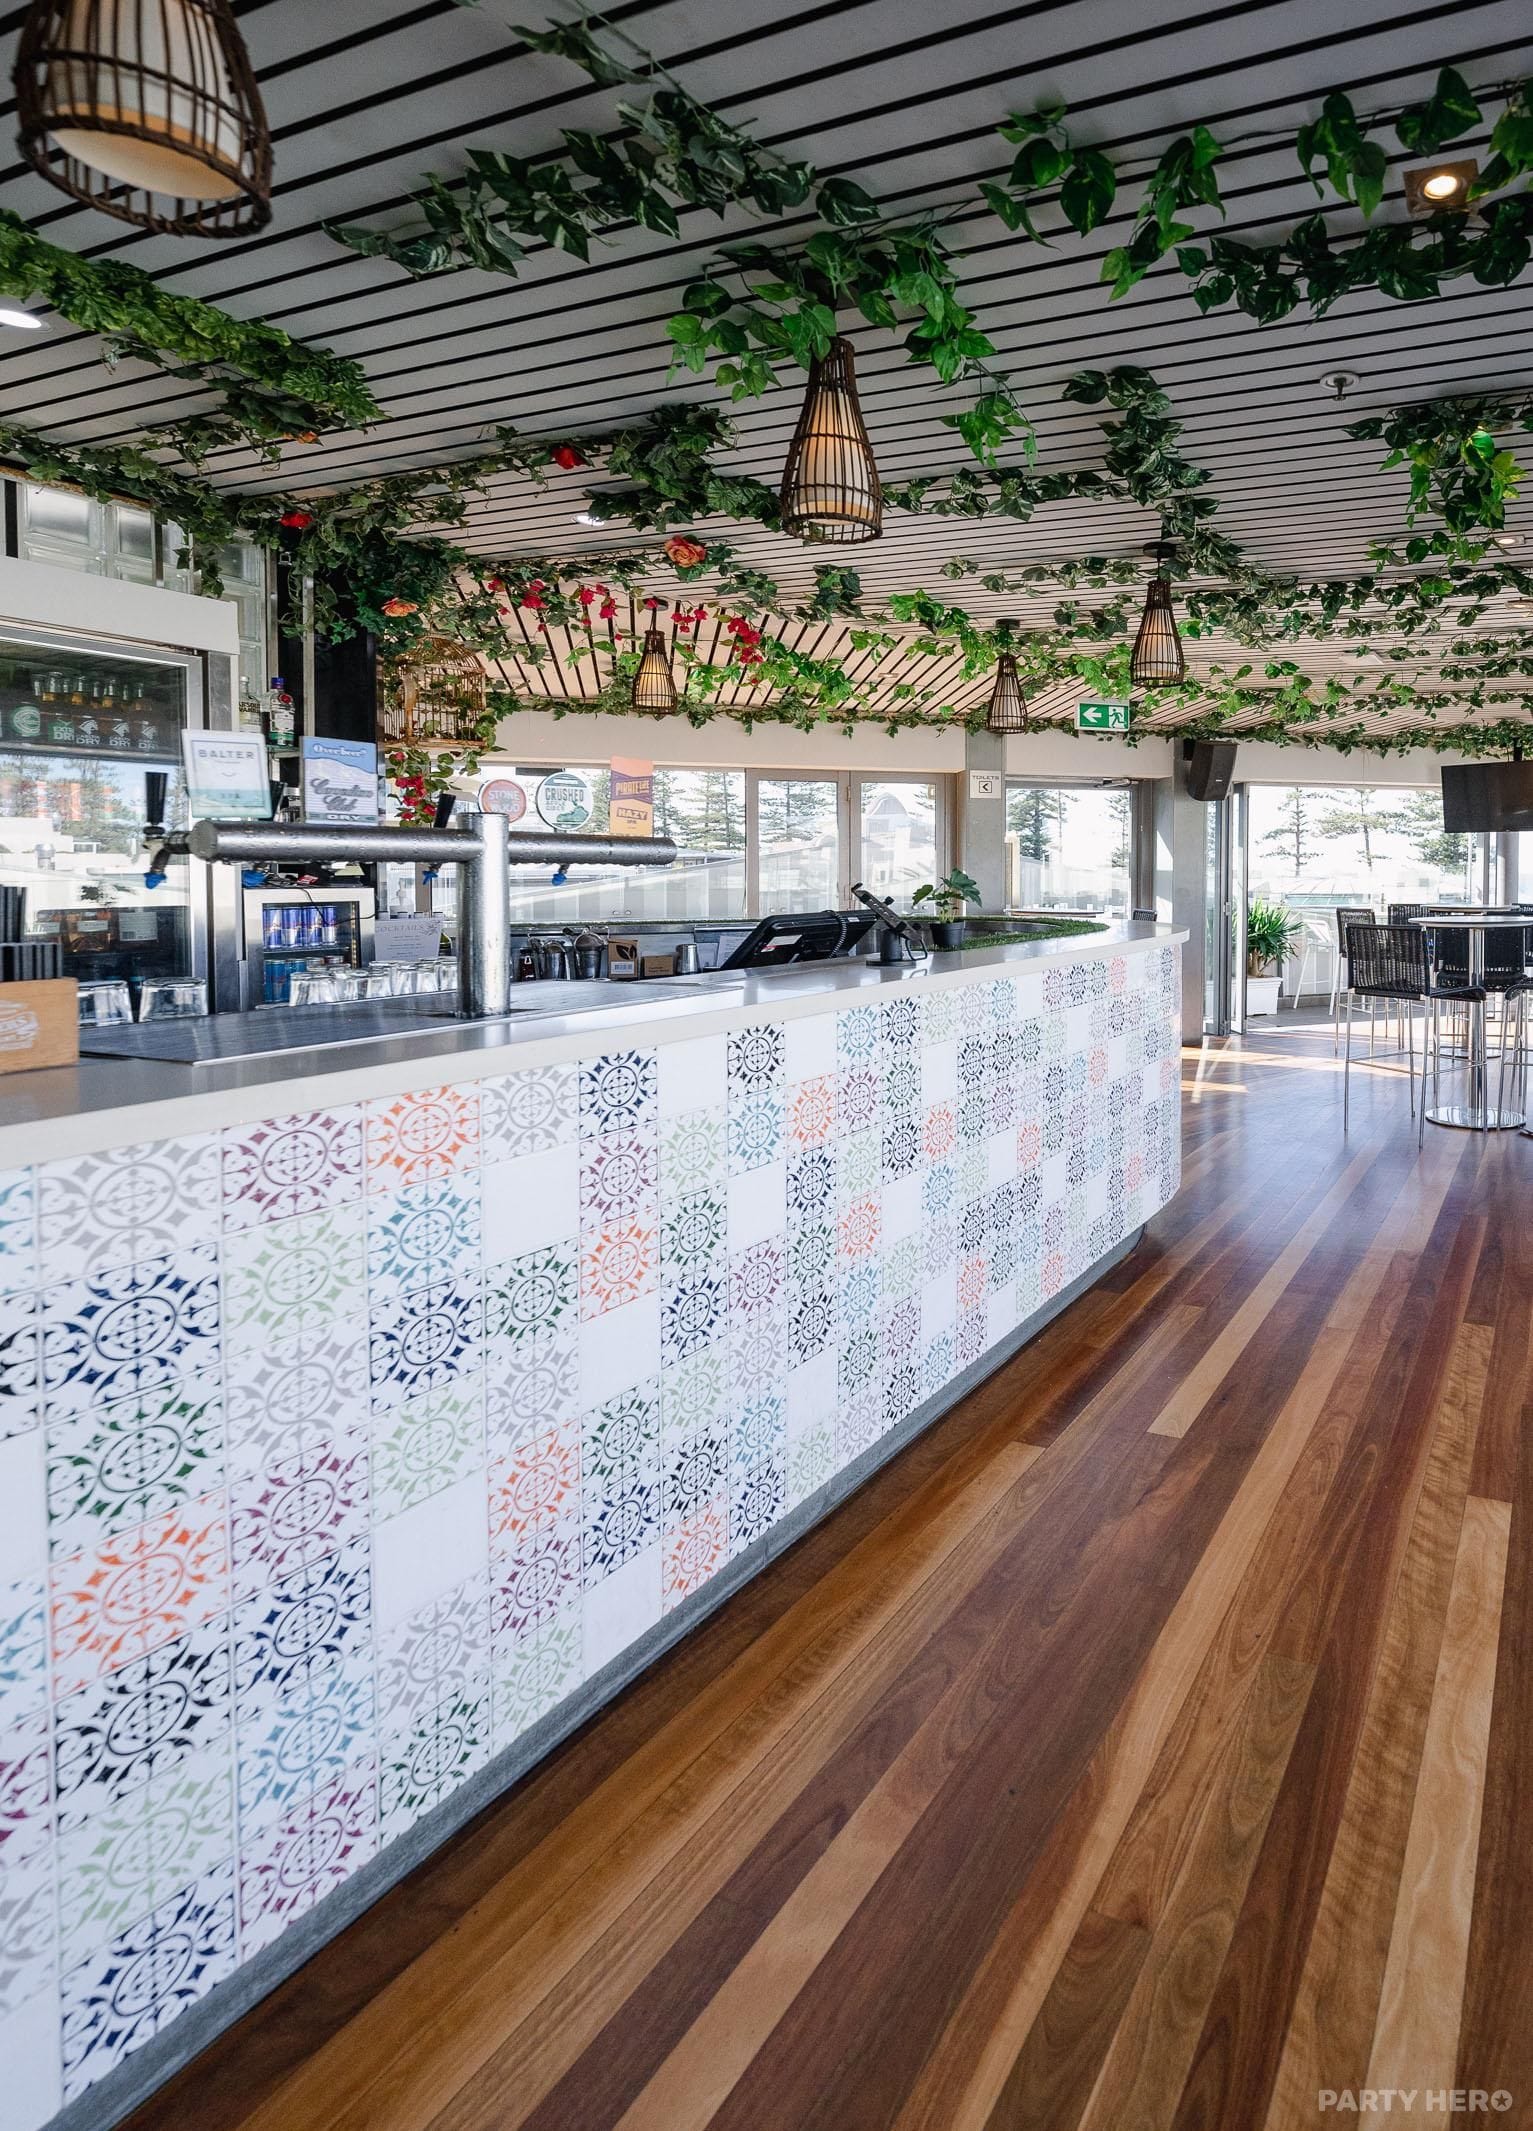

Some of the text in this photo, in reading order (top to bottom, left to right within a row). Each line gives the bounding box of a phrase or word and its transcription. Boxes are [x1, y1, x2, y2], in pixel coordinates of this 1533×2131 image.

[198, 749, 255, 759] BALTER
[488, 789, 520, 801] STONE
[545, 787, 584, 801] CRUSHED
[326, 813, 360, 821] DRY
[617, 807, 648, 820] HAZY
